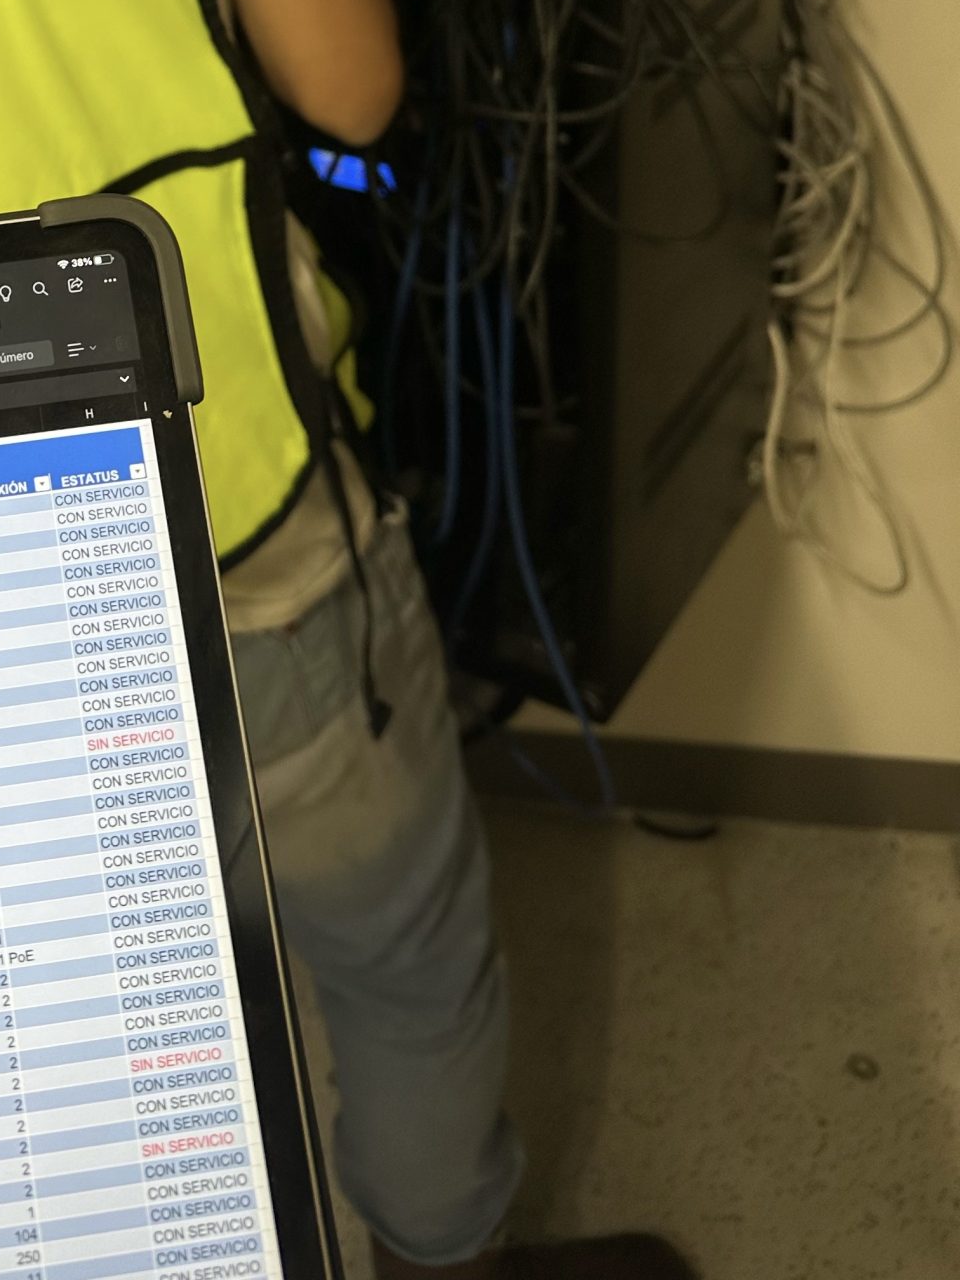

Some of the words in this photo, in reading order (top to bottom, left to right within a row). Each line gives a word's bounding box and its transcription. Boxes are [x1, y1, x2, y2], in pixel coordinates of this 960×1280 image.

[71, 256, 92, 267] 38%
[61, 469, 119, 487] ESTATUS
[54, 492, 82, 506] CON
[85, 484, 144, 502] SERVICIO
[59, 528, 87, 543] CON
[90, 520, 150, 539] SERVICIO
[64, 566, 92, 580] CON
[95, 557, 155, 575] SERVICIO
[71, 622, 100, 636] CON
[103, 613, 164, 632] SERVICIO
[79, 679, 108, 693] CON
[111, 670, 173, 689] SERVICIO
[87, 737, 109, 751] SIN
[112, 728, 174, 747] SERVICIO
[95, 794, 124, 809] CON
[127, 785, 190, 805] SERVICIO
[103, 853, 133, 868] CON
[135, 844, 199, 864] SERVICIO
[111, 913, 141, 928] CON
[144, 903, 207, 924] SERVICIO
[8, 949, 34, 964] PoE
[119, 973, 149, 989] CON
[152, 964, 216, 984] SERVICIO
[130, 1058, 153, 1072] SIN
[156, 1047, 222, 1068] SERVICIO
[142, 1142, 165, 1157] SIN
[168, 1131, 234, 1153] SERVICIO
[150, 1205, 182, 1223] CON
[184, 1194, 251, 1217] SERVICIO
[14, 1228, 37, 1242] 104
[16, 1249, 40, 1266] 250
